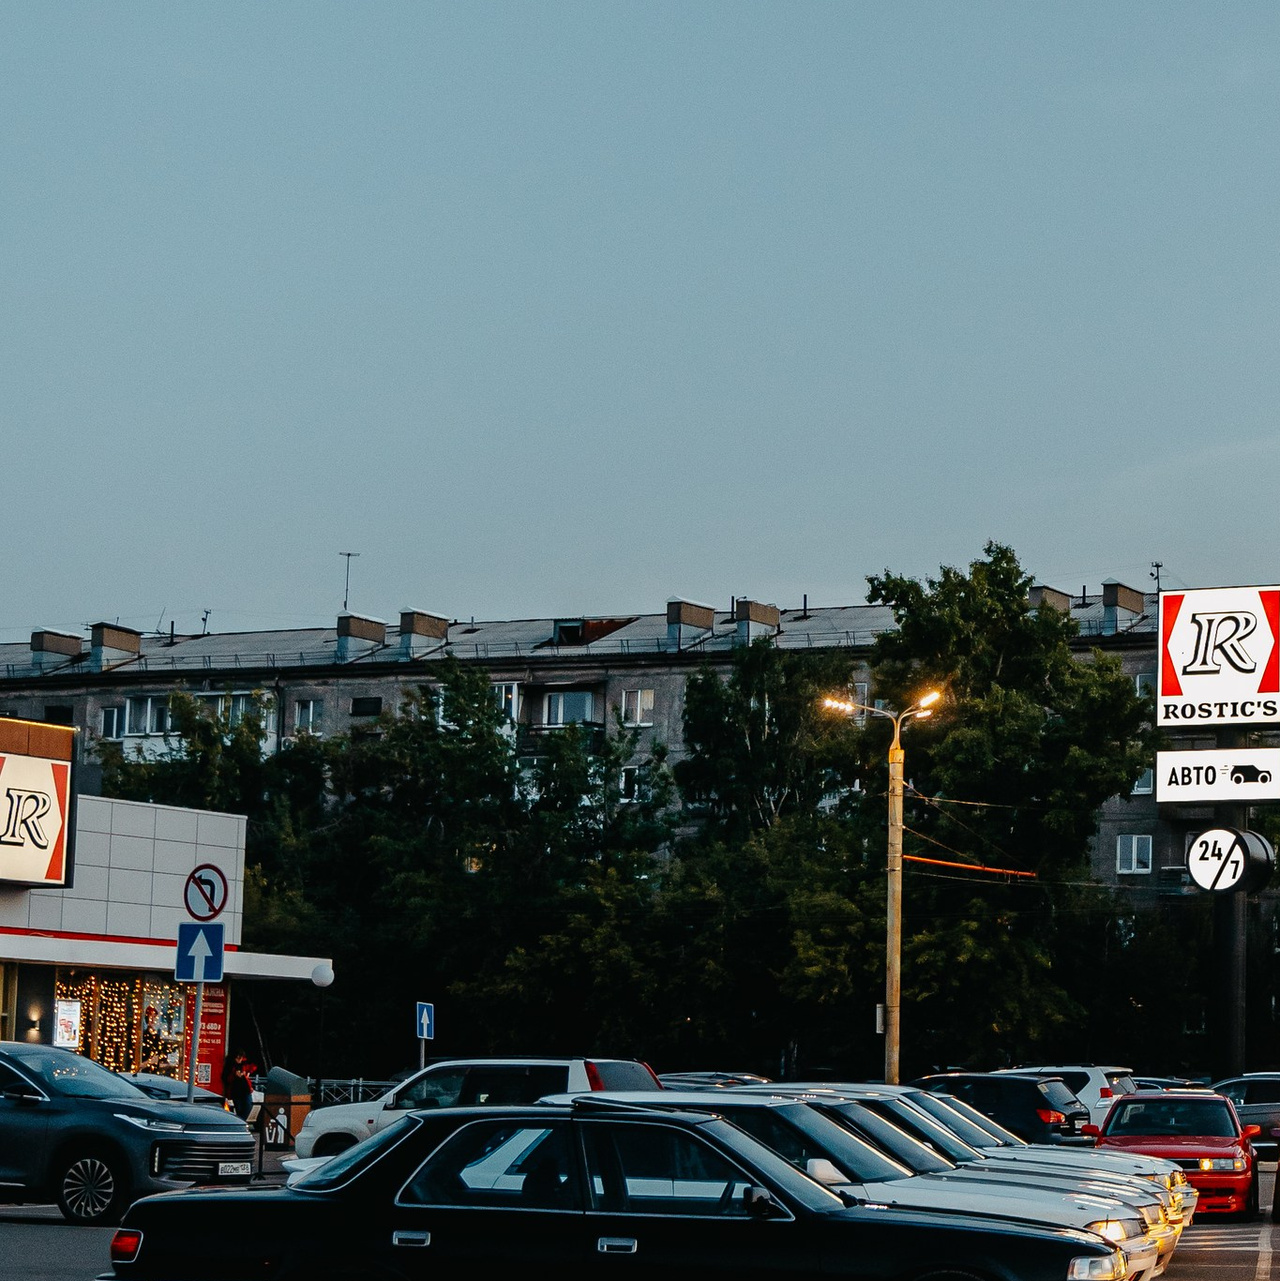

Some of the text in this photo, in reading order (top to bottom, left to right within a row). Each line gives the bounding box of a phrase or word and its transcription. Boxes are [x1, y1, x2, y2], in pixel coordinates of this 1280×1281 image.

[1182, 611, 1257, 676] R
[1163, 700, 1278, 719] ROSTIC'S
[1167, 765, 1216, 786] АВТО
[0, 787, 51, 850] R
